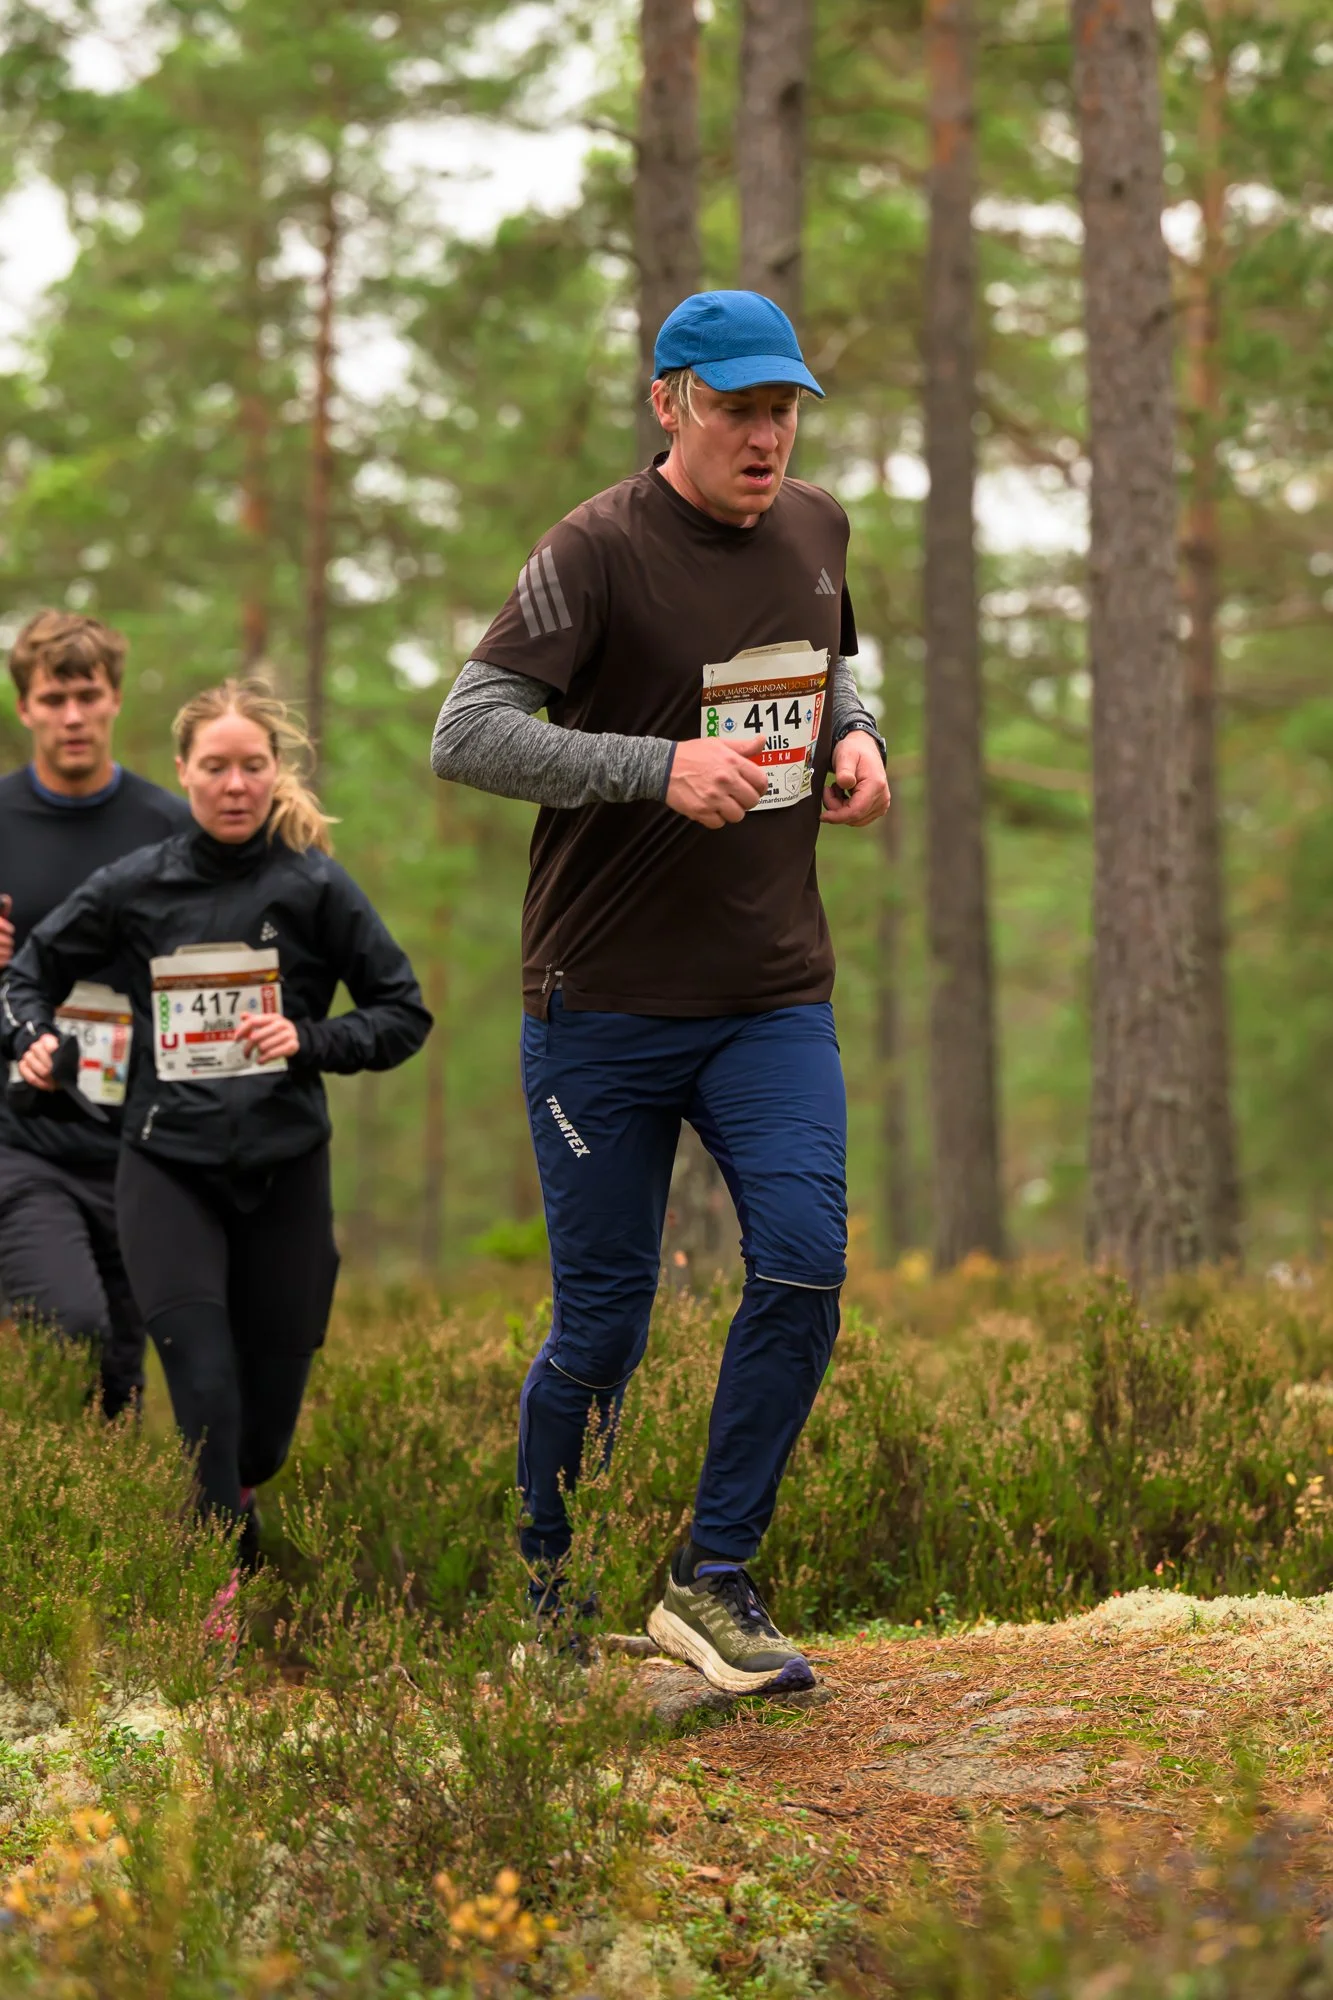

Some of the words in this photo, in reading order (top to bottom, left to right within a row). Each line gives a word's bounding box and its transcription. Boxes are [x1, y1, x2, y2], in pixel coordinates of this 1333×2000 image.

[743, 699, 802, 734] 414
[764, 734, 790, 751] Nils
[762, 753, 773, 763] 15
[778, 751, 791, 762] KM
[191, 991, 241, 1017] 417
[546, 1094, 591, 1158] TRIMTEX
